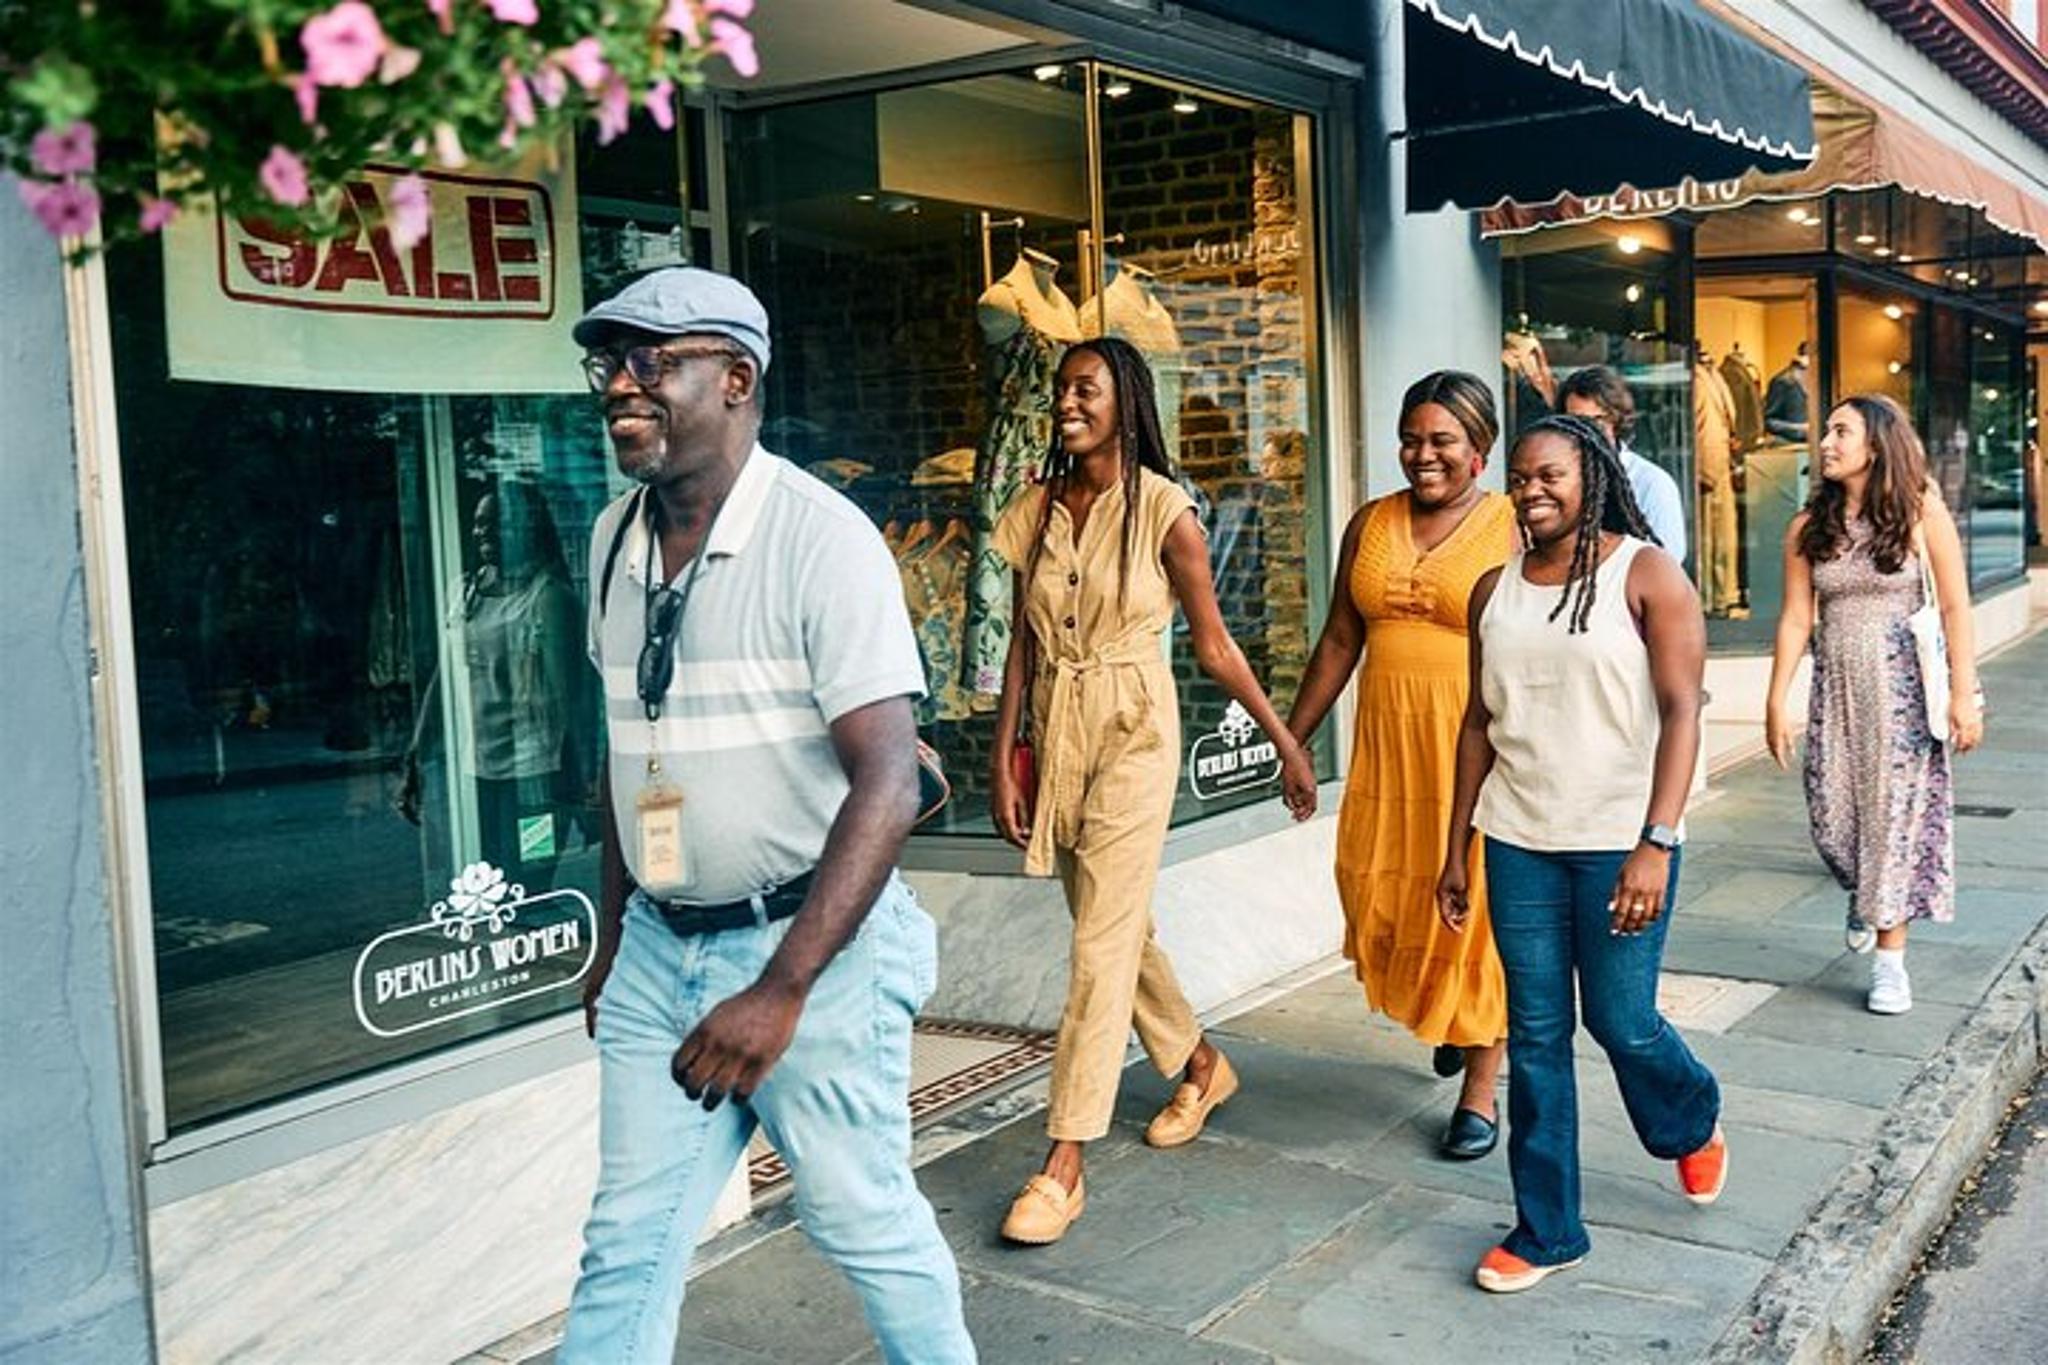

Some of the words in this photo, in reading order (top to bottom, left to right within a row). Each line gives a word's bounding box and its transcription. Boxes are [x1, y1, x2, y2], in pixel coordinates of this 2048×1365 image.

[236, 181, 541, 301] SALE
[376, 946, 481, 1004] BERLINS
[490, 920, 579, 970] WOMEN
[428, 971, 531, 1007] CHARLESTON
